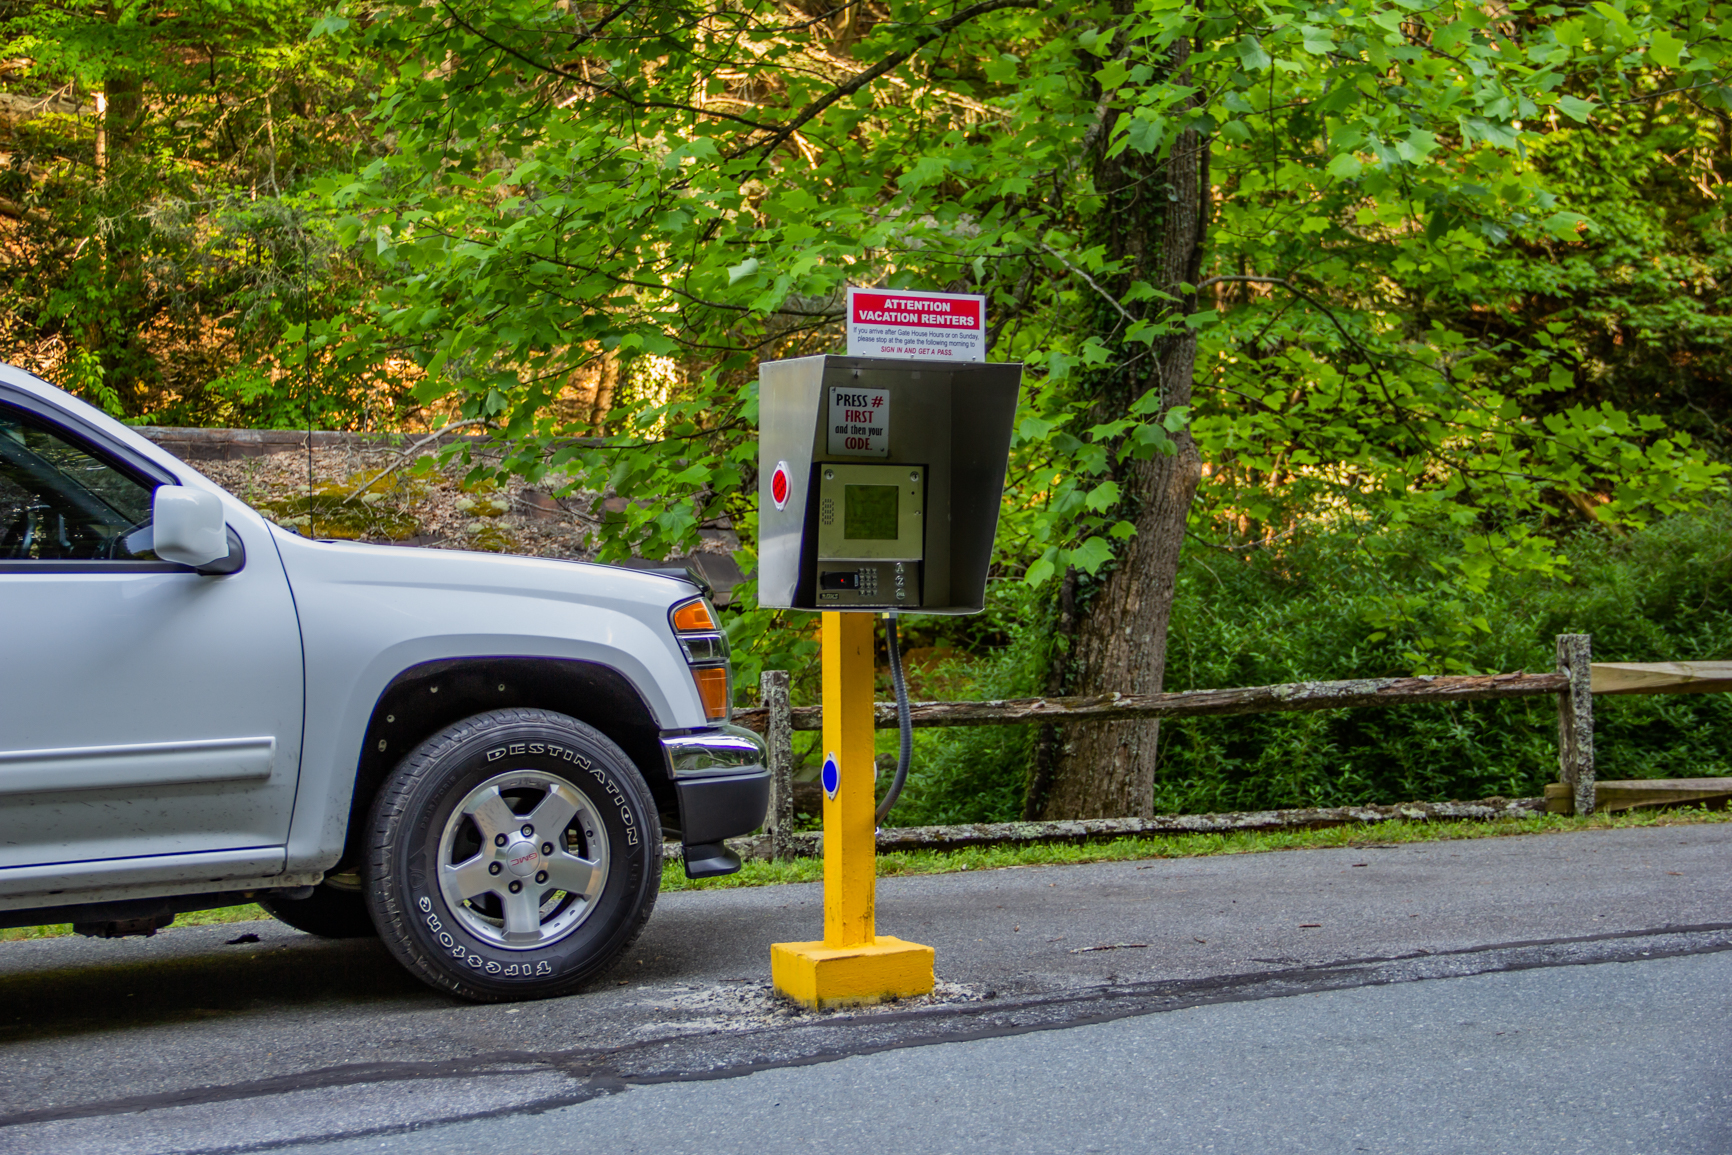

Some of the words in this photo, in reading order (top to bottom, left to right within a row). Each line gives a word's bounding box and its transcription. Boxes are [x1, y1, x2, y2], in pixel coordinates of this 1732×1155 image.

[884, 299, 950, 312] ATTENTION
[859, 310, 918, 323] VACATION
[921, 314, 974, 326] RENTERS
[857, 335, 875, 343] please
[876, 336, 887, 344] stop
[926, 339, 948, 348] following
[949, 341, 969, 349] morning
[881, 345, 895, 353] SIGN
[836, 393, 868, 408] PRESS
[871, 395, 884, 408] #
[845, 409, 874, 423] FIRST
[835, 423, 848, 434] and
[850, 424, 866, 435] then
[868, 427, 883, 437] your
[844, 436, 873, 451] CODE.
[486, 743, 639, 846] DESTINATION
[510, 852, 538, 867] GMC
[418, 896, 552, 977] Firestone
